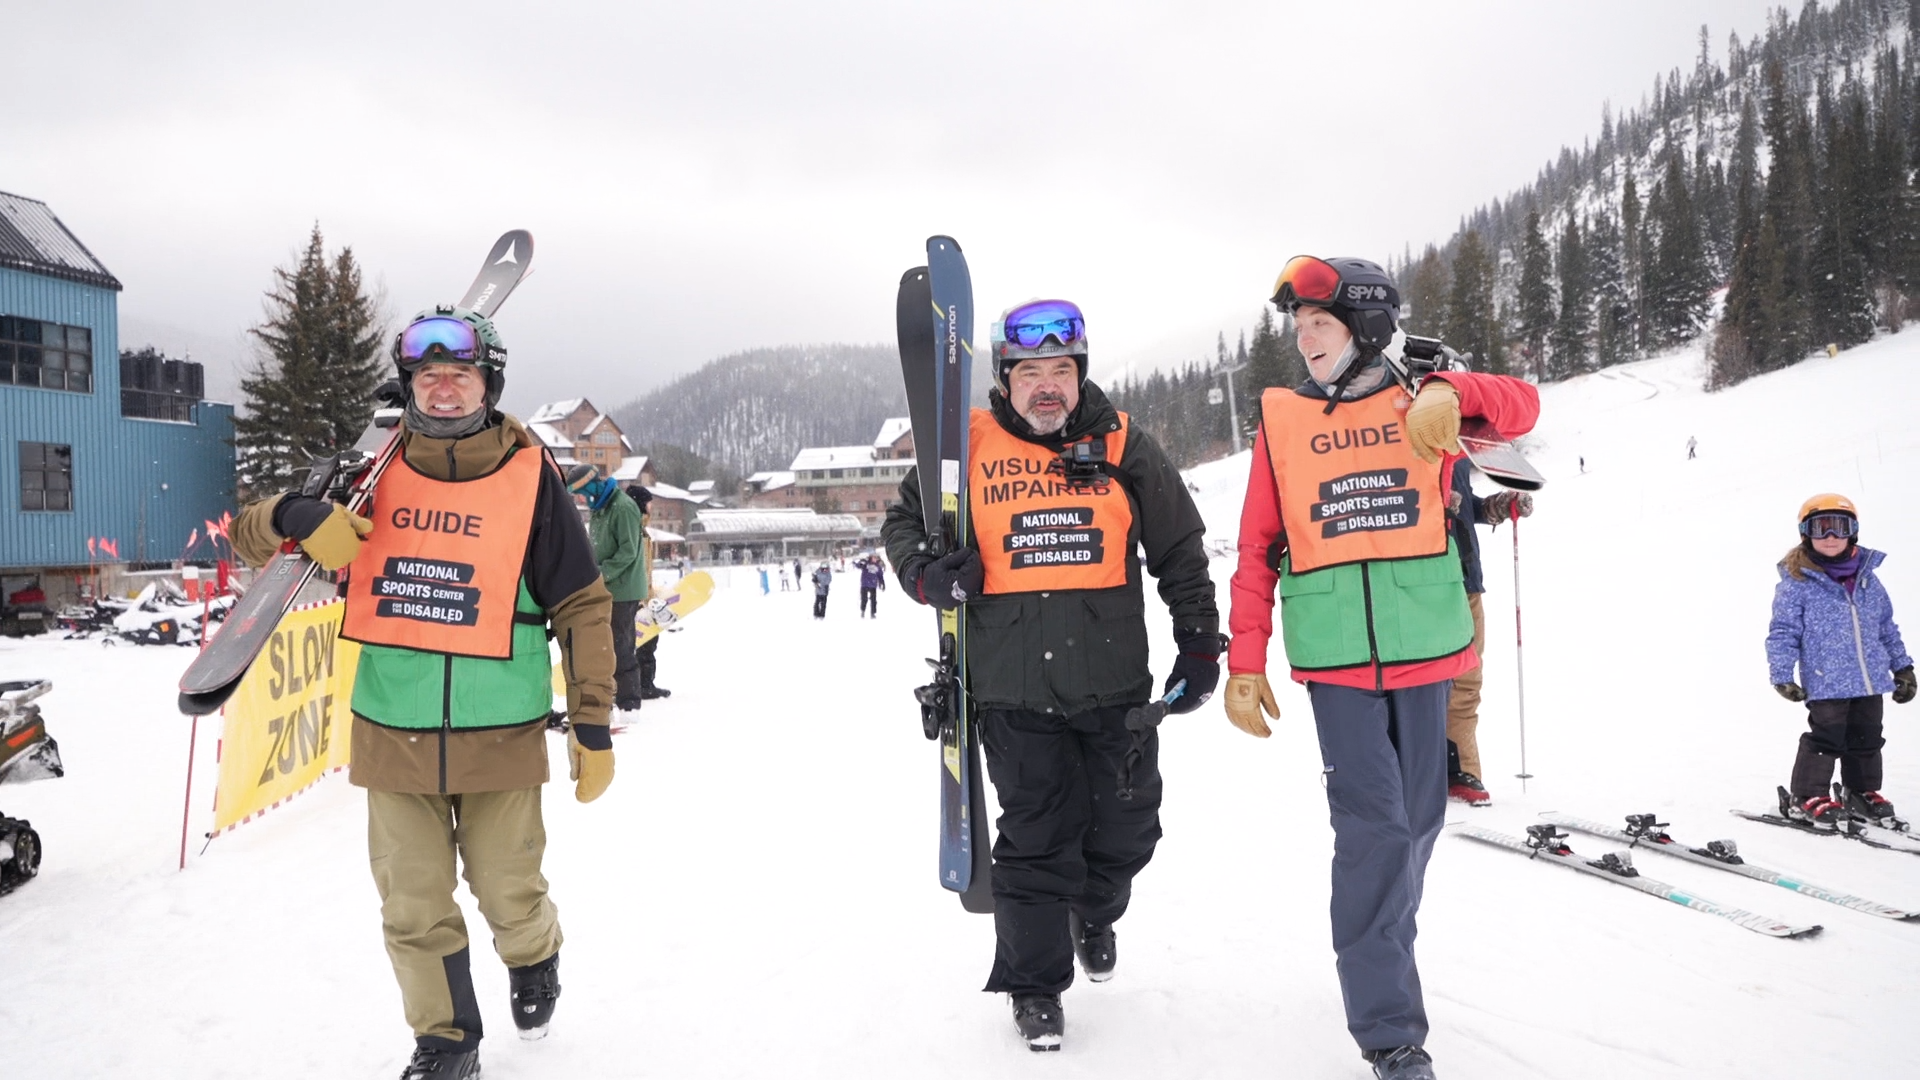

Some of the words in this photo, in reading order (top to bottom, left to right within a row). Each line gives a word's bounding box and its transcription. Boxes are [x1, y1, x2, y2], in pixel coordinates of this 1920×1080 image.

[471, 283, 497, 313] ATOM
[1347, 285, 1374, 300] SPY
[1310, 422, 1402, 455] GUIDE
[981, 458, 1063, 480] VISUA
[1331, 474, 1395, 495] NATIONAL
[1321, 497, 1370, 517] SPORTS
[1371, 496, 1404, 507] CENTER
[391, 507, 483, 538] GUIDE
[1022, 513, 1082, 527] NATIONAL
[1348, 513, 1408, 530] DISABLED
[1011, 533, 1058, 548] SPORTS
[1059, 534, 1090, 543] CENTER
[1034, 550, 1091, 563] DISABLED
[397, 562, 460, 581] NATIONAL
[381, 580, 431, 598] SPORTS
[432, 589, 464, 601] CENTER
[403, 603, 463, 621] DISABLED
[269, 619, 336, 701] SLOW
[258, 694, 333, 787] ZONE
